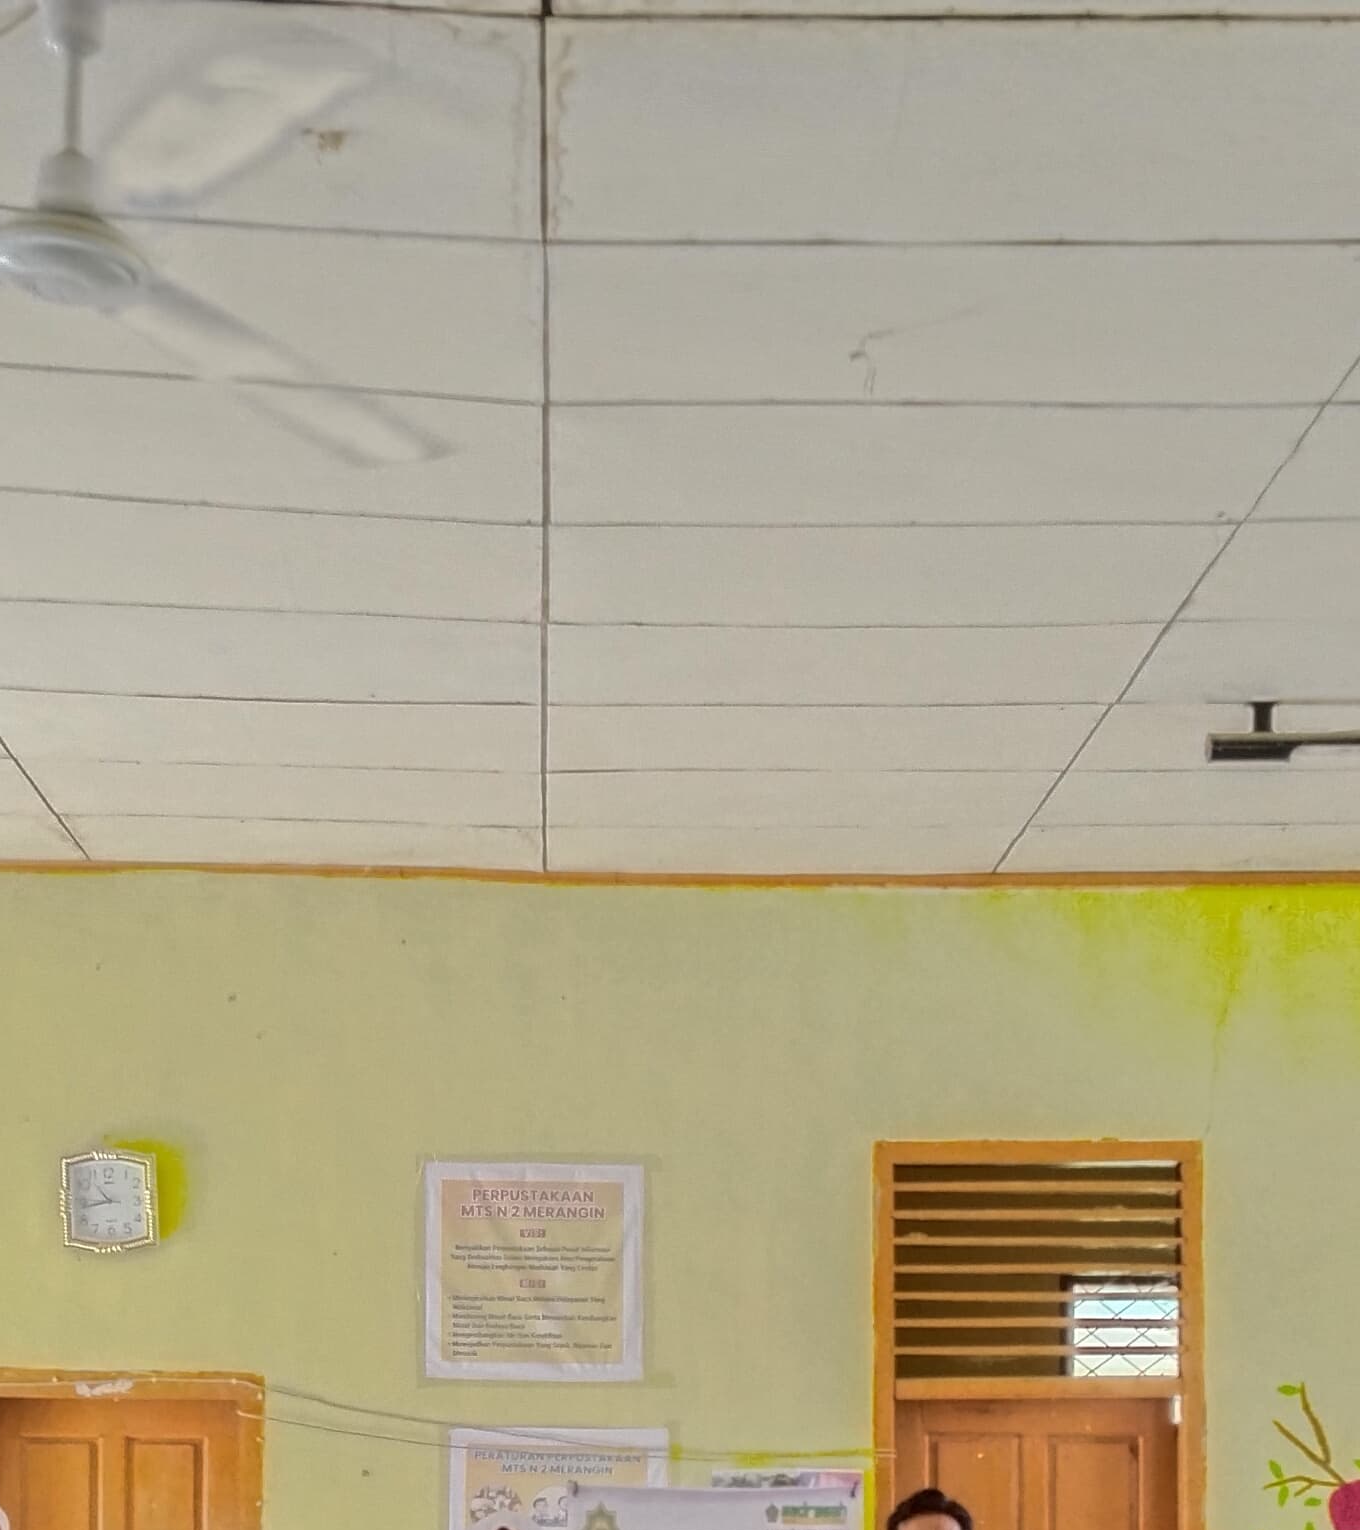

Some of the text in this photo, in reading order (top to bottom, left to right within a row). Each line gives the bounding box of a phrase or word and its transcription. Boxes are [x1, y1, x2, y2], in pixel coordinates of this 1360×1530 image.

[472, 1189, 594, 1203] PERPUSTAKAAN
[461, 1205, 605, 1219] MTS N 2 MERANGIN
[474, 1450, 547, 1461] PERATURAN
[502, 1464, 527, 1473] MTS
[529, 1464, 539, 1473] N
[541, 1464, 547, 1473] 2
